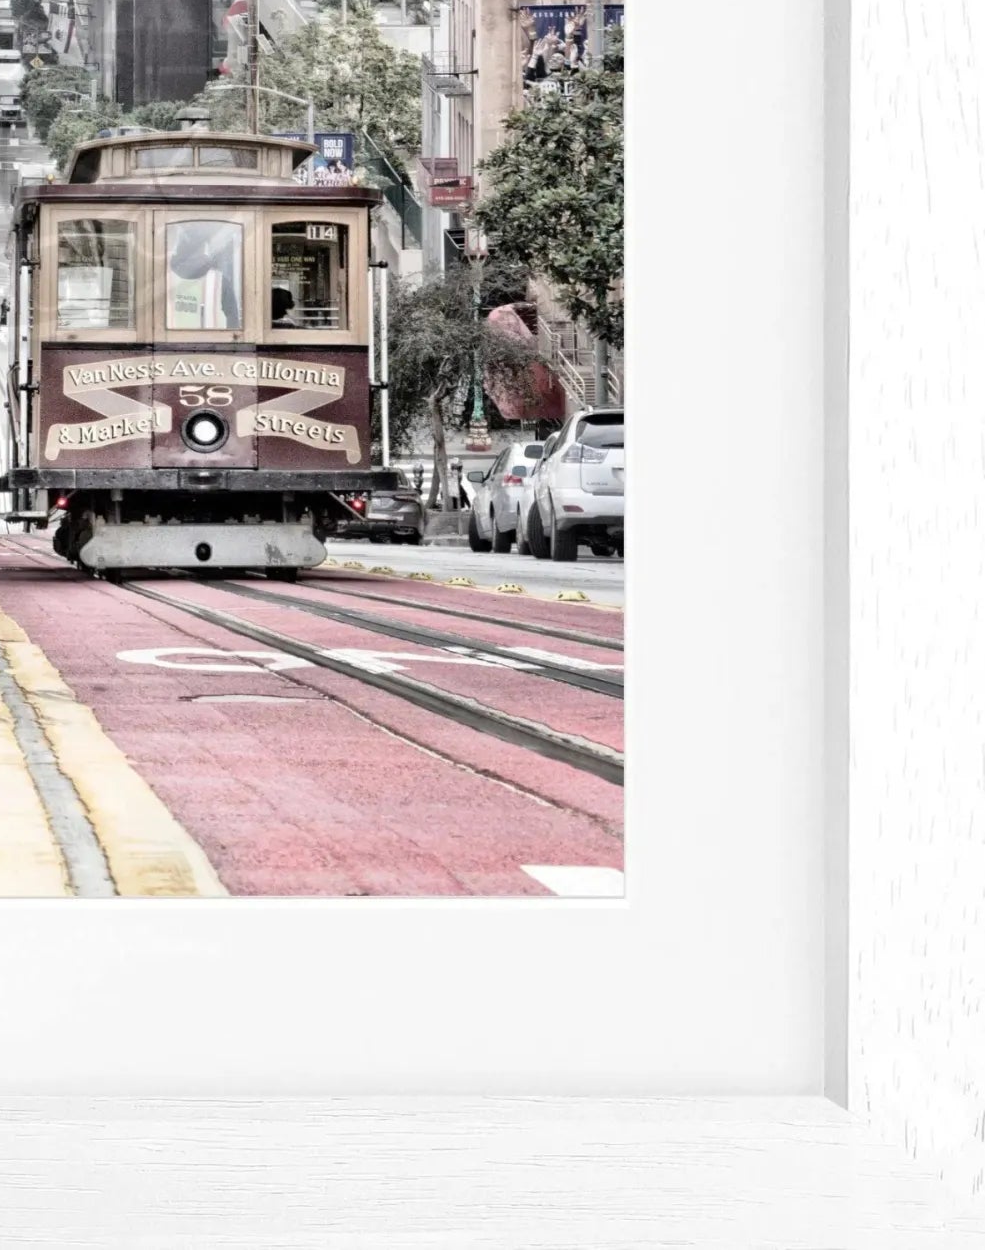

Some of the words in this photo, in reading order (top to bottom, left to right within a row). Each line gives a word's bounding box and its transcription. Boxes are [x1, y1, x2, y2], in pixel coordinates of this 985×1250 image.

[323, 139, 343, 147] BOLD
[323, 148, 343, 157] NOW
[68, 368, 106, 386] Van
[108, 362, 165, 381] Ness
[232, 361, 340, 387] California
[179, 385, 233, 407] 58
[59, 426, 74, 444] &
[79, 411, 162, 444] Market
[254, 414, 346, 443] Streets
